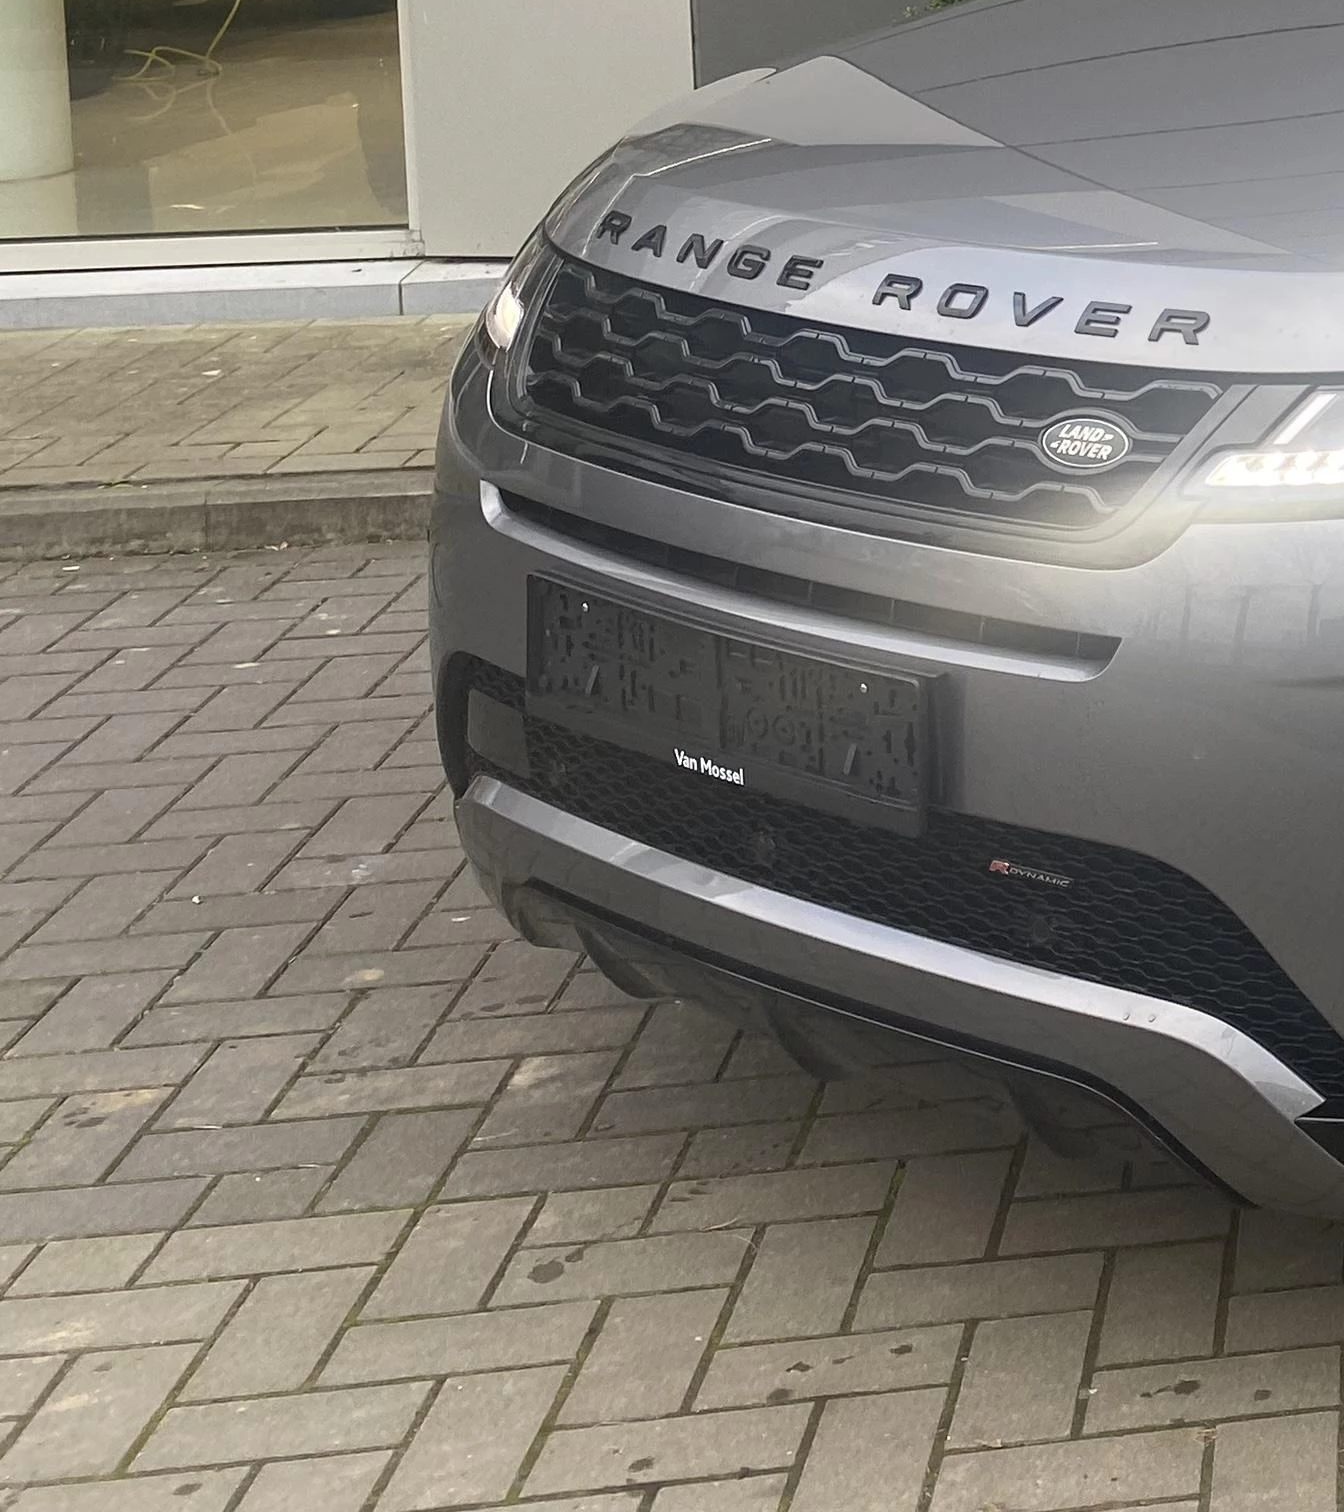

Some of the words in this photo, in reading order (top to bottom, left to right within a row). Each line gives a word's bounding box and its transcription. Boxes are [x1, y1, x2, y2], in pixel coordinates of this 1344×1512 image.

[597, 209, 824, 291] RANGE
[871, 272, 1210, 346] ROVER
[1058, 424, 1106, 442] LAND
[1057, 439, 1113, 460] ROVER
[674, 748, 698, 771] Van
[700, 757, 744, 785] Mossel
[1009, 867, 1071, 888] DYNAMIC
